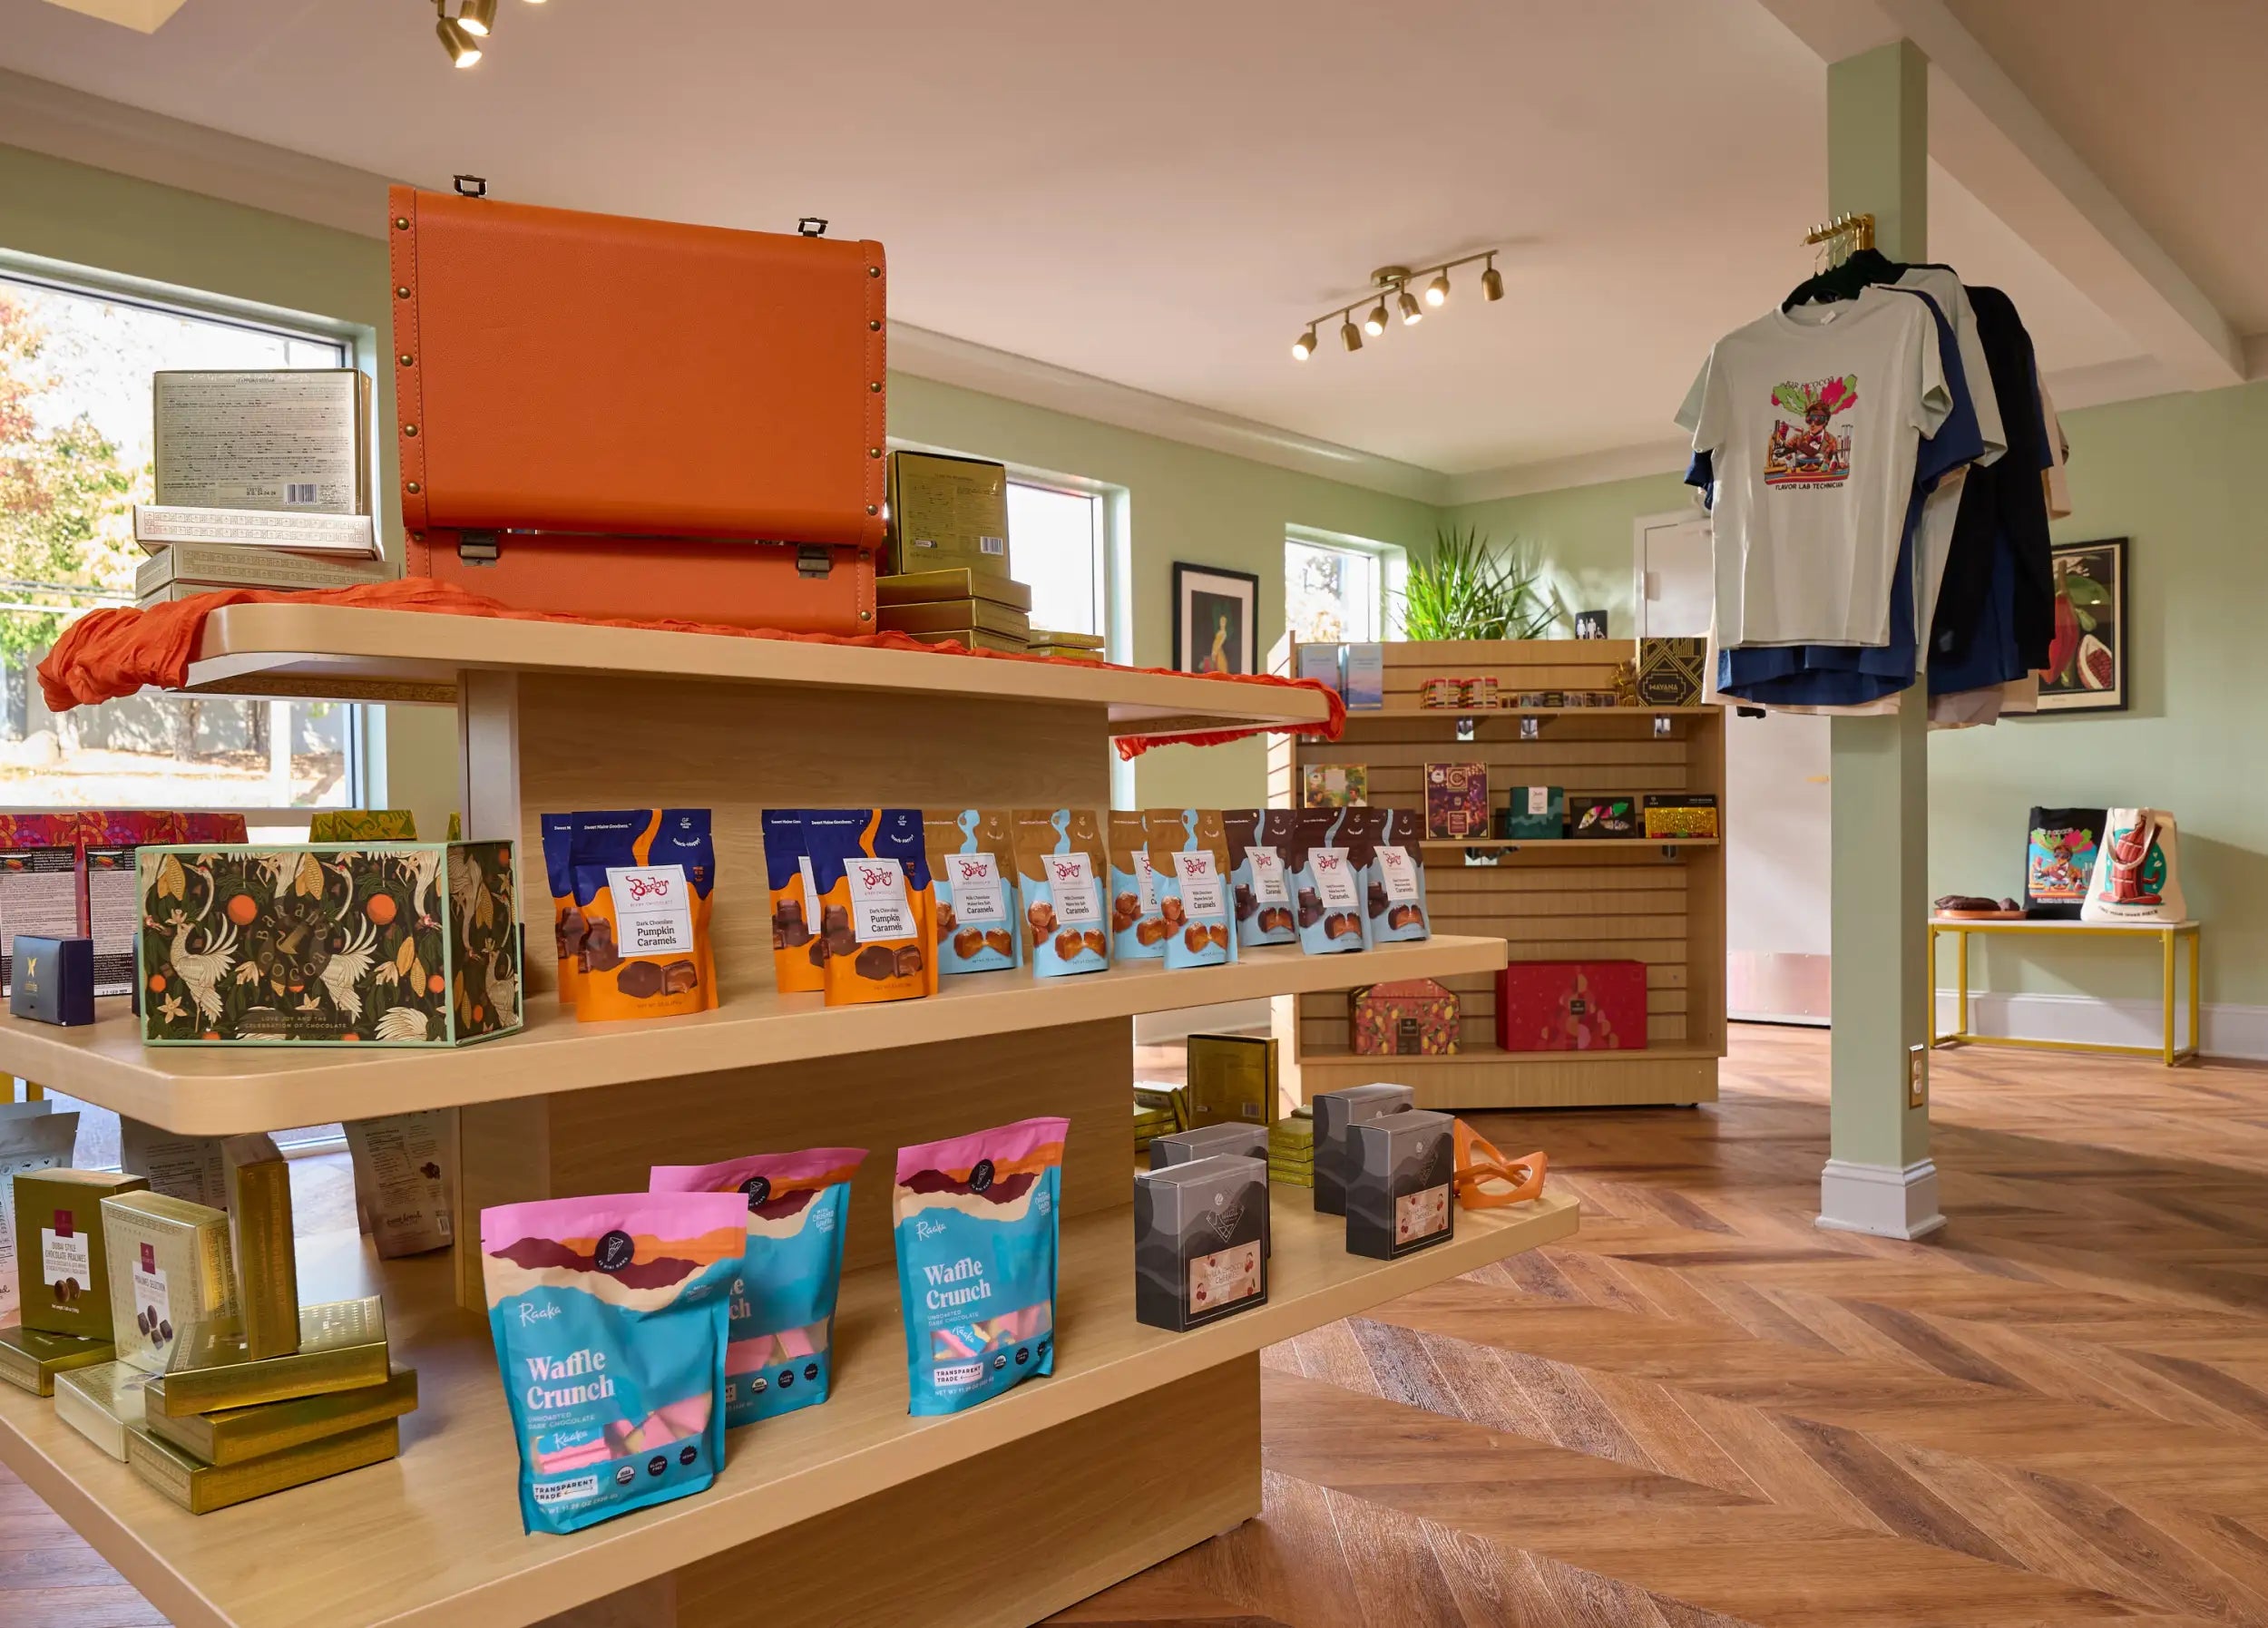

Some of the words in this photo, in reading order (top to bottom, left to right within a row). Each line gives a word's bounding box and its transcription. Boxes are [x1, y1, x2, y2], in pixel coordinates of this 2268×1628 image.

[1813, 481, 1843, 490] TECHNICIAN
[1183, 857, 1207, 876] Bixby
[1317, 853, 1339, 872] Bixby
[959, 861, 988, 880] Bixby
[1052, 861, 1080, 881] Bixby
[859, 866, 893, 890] Bixby
[625, 875, 670, 902] Bixby
[966, 906, 994, 914] Caramels
[1065, 907, 1090, 915] Caramels
[871, 914, 901, 923] Pumpkin
[637, 925, 675, 937] Pumpkin
[871, 922, 904, 932] Caramels
[637, 935, 677, 947] Caramels
[915, 1221, 946, 1241] Raaka
[52, 1242, 64, 1250] DUBAI
[65, 1243, 76, 1252] STYLE
[45, 1250, 67, 1260] CHOCOLATE
[68, 1252, 86, 1262] PRALINES
[923, 1257, 983, 1286] Waffle
[926, 1279, 992, 1310] Crunch
[518, 1301, 562, 1328] Raaka
[928, 1310, 962, 1320] UNROASTED
[944, 1311, 979, 1323] CHOCOLATE
[526, 1349, 606, 1382] Waffle
[936, 1365, 981, 1376] TRANSPARENT
[526, 1374, 615, 1410] Crunch
[527, 1411, 572, 1423] UNROASTED
[549, 1414, 596, 1428] CHOCOLATE
[650, 1460, 666, 1468] GLUTEN
[535, 1478, 594, 1494] TRANSPARENT
[535, 1492, 562, 1500] TRADE
